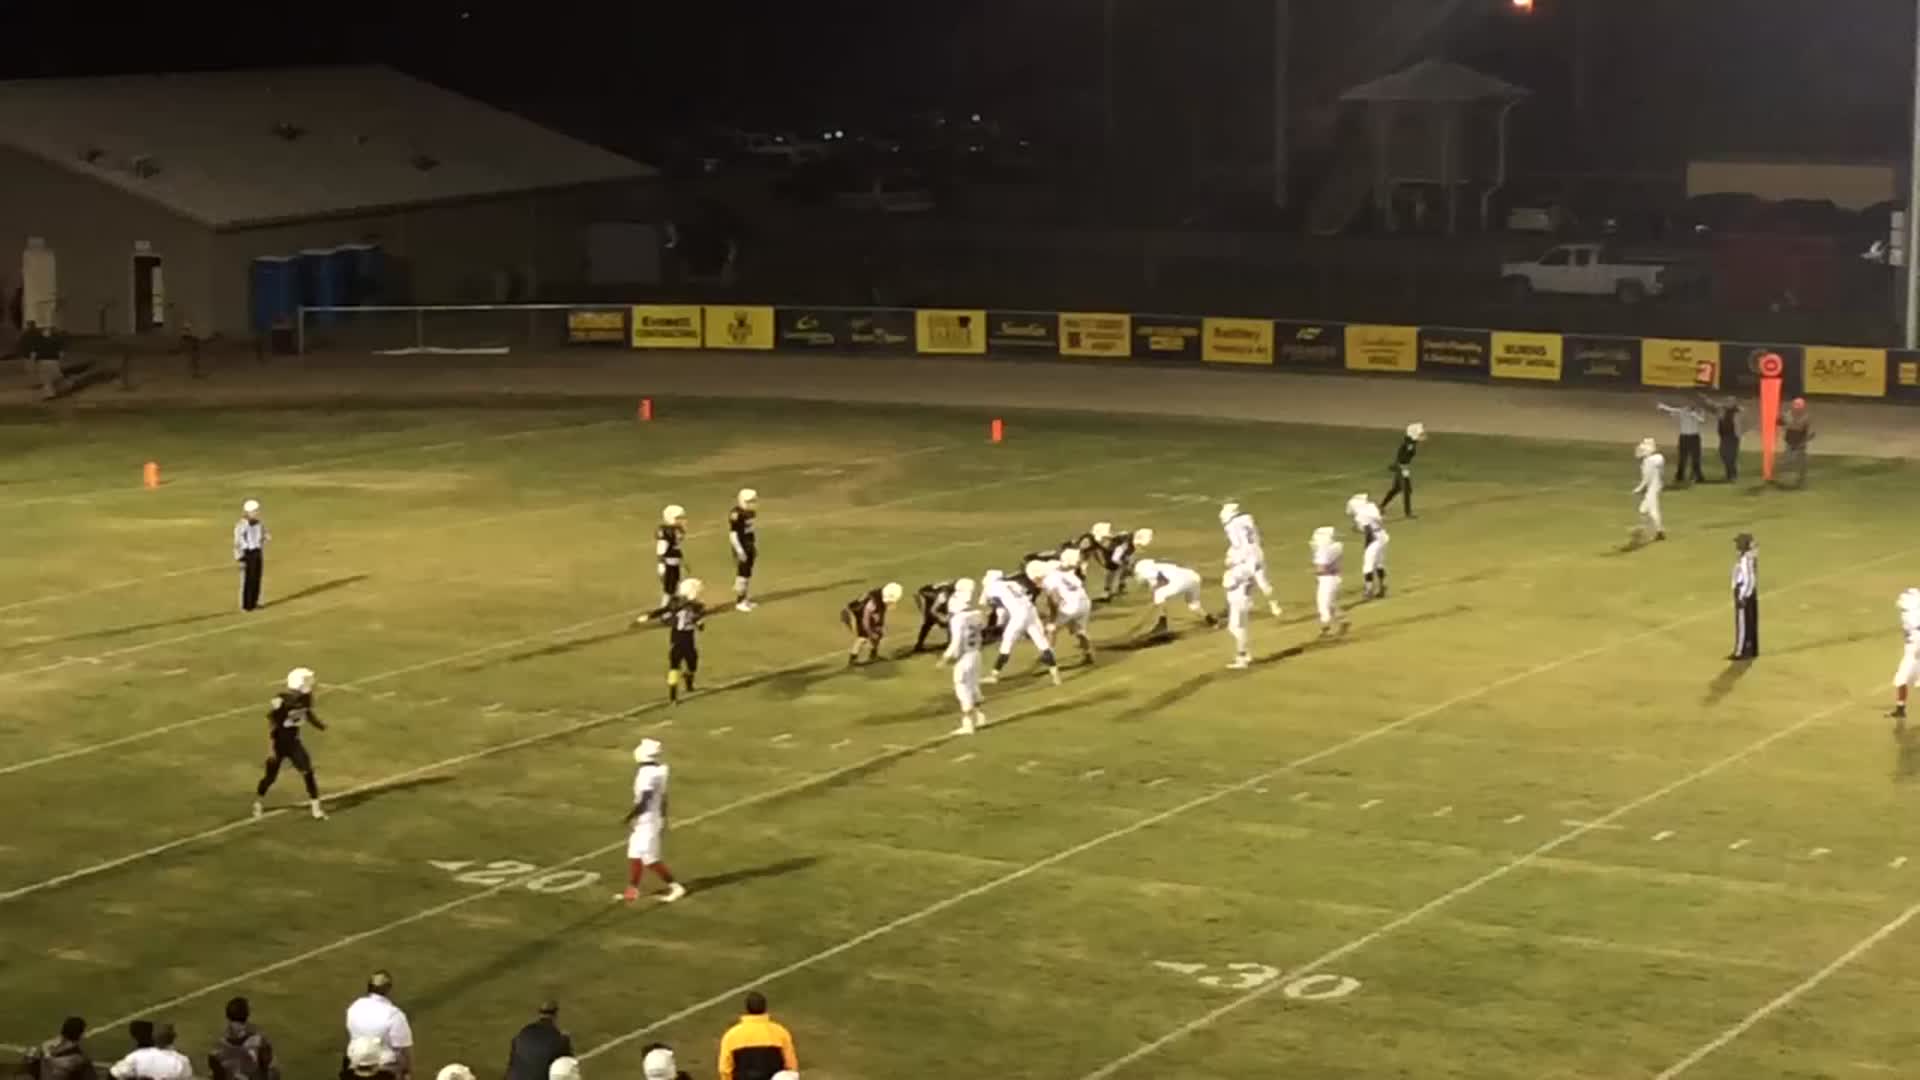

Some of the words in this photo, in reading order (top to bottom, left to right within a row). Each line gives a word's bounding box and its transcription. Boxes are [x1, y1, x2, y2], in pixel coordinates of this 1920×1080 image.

[1813, 358, 1867, 377] AMC
[454, 859, 601, 893] 20
[1197, 962, 1362, 1000] 30
